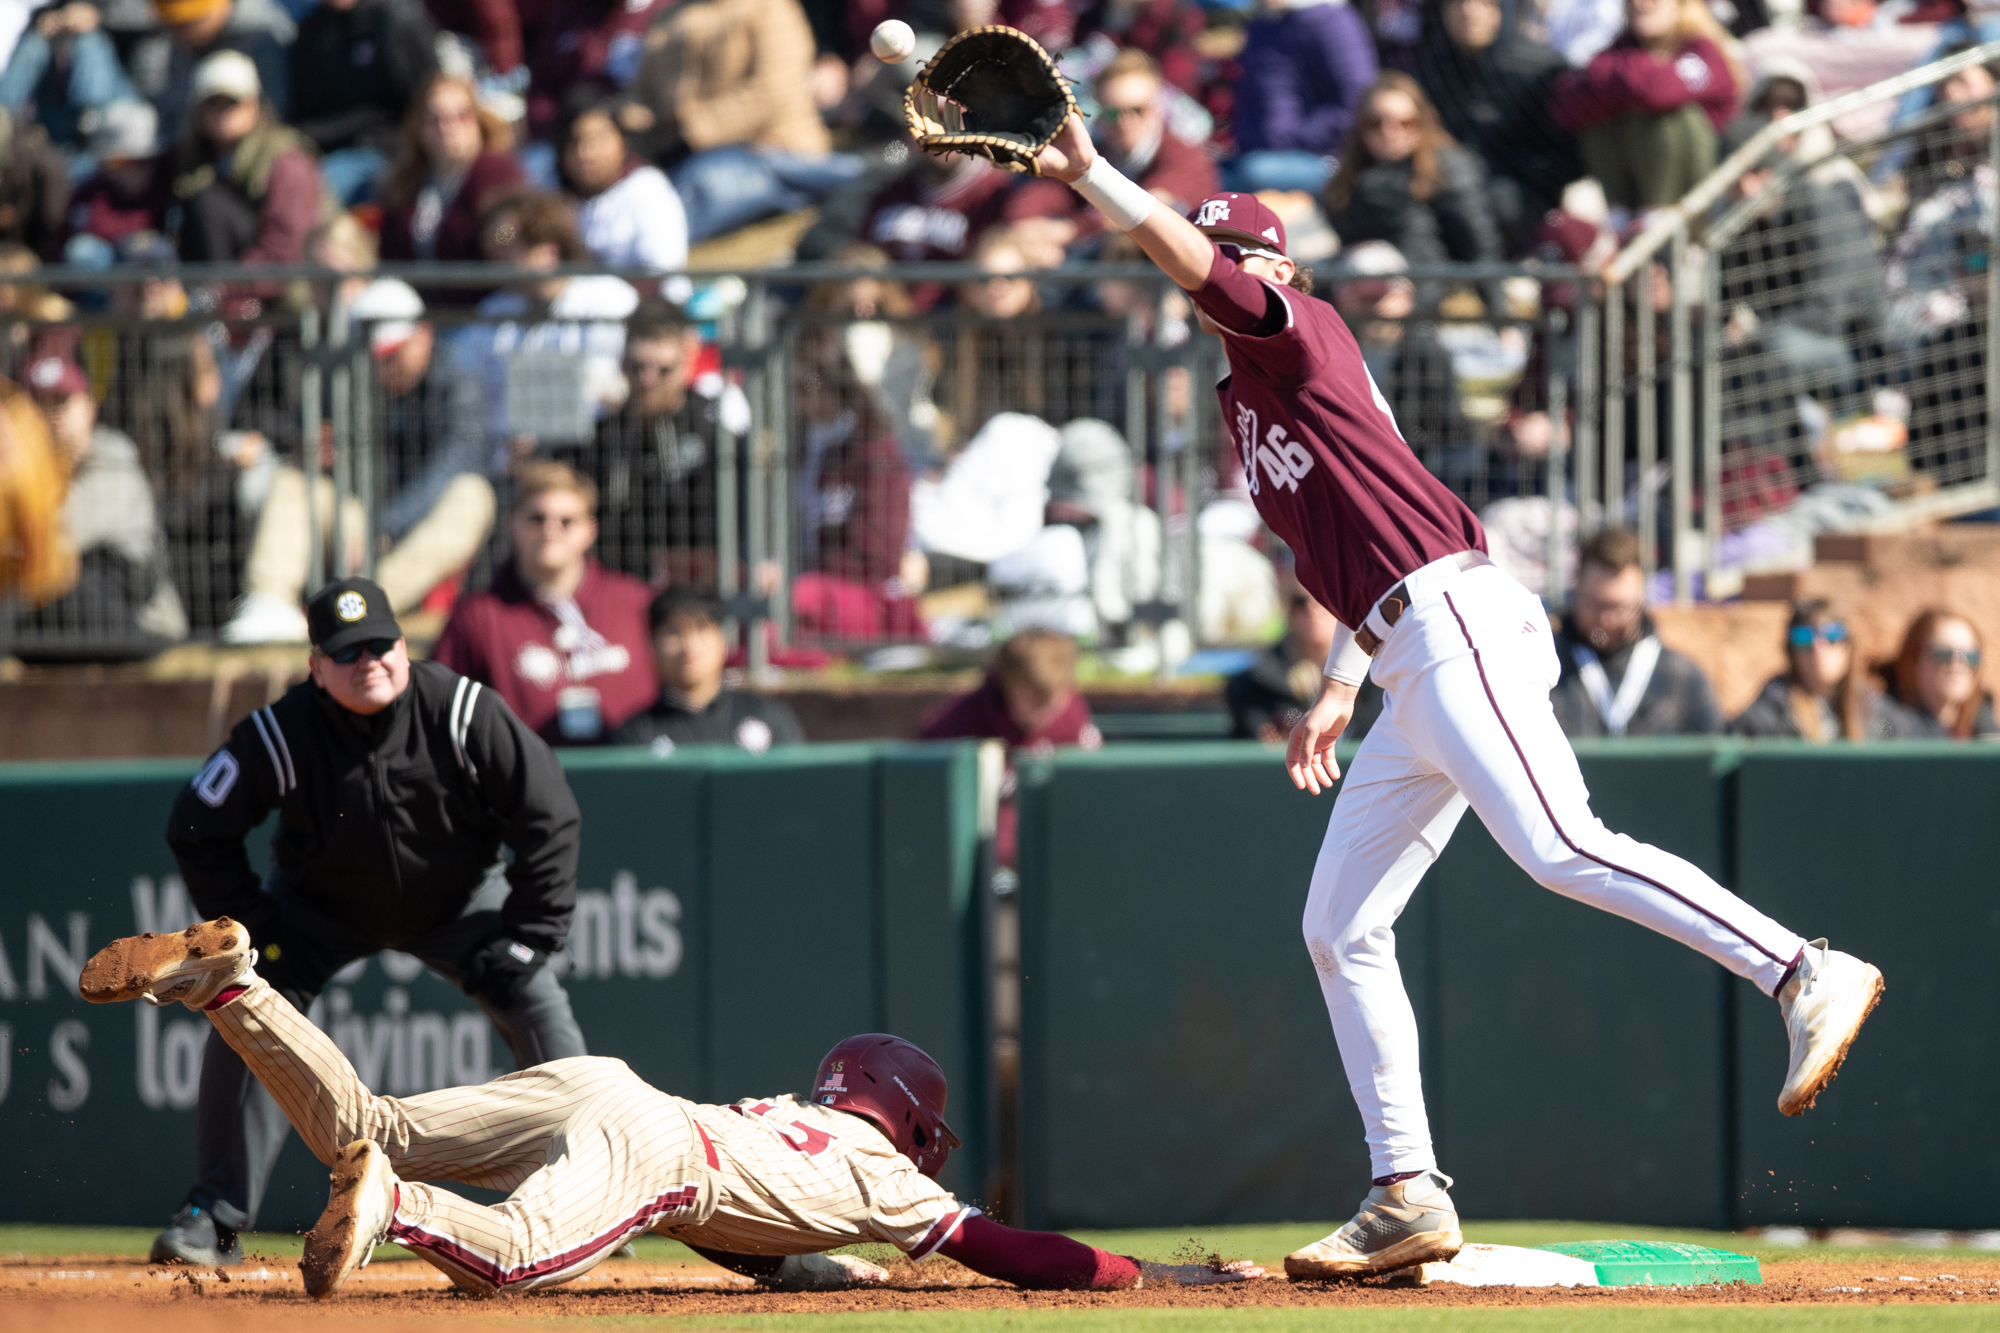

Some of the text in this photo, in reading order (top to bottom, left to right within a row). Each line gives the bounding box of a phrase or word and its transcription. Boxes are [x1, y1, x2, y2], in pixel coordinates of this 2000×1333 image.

[1257, 424, 1315, 494] 46
[193, 749, 240, 806] 0
[831, 1061, 843, 1072] 15
